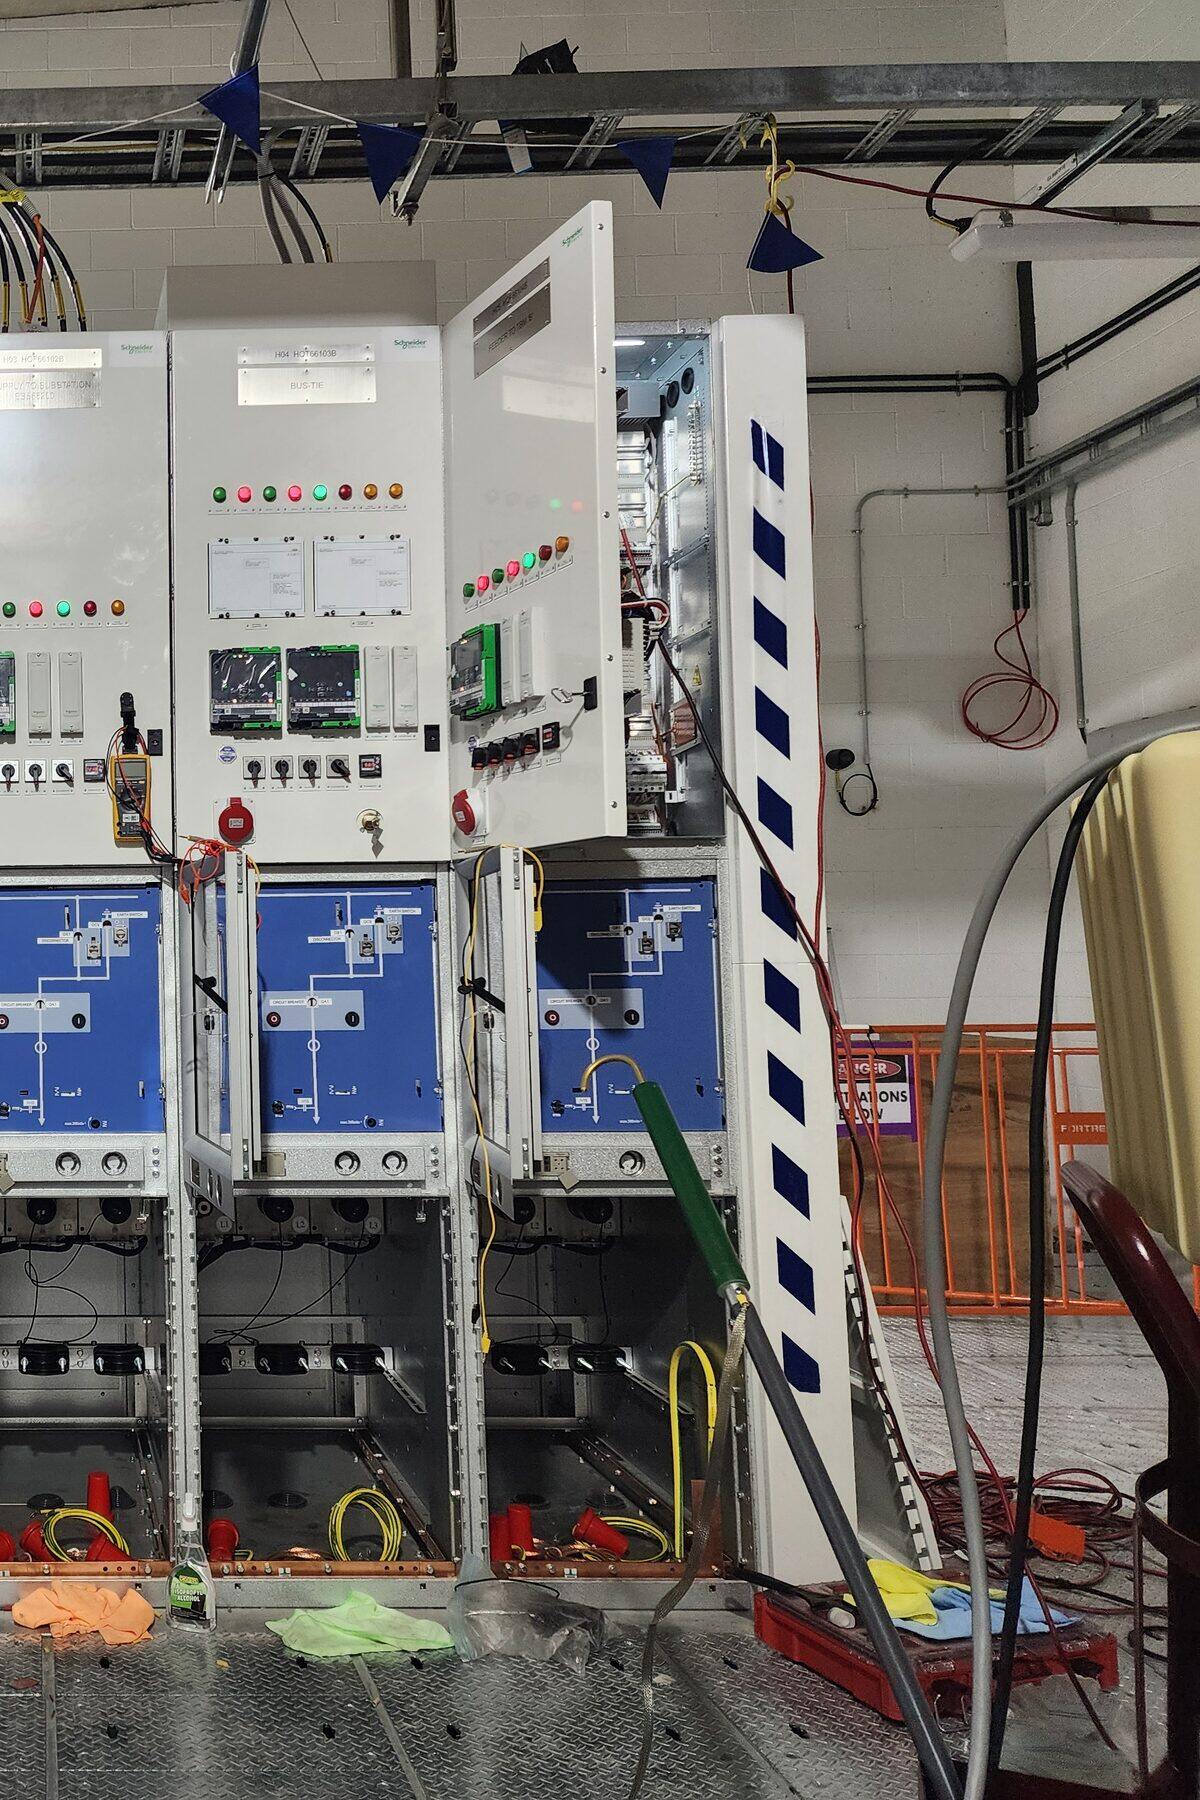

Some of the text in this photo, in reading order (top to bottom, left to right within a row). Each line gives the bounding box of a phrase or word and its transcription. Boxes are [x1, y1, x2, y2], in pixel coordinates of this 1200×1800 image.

[394, 339, 427, 349] Schneider
[120, 344, 154, 354] Schneider
[25, 381, 37, 390] TO
[39, 381, 92, 390] SUBSTATION
[290, 381, 324, 390] BUS-TIE
